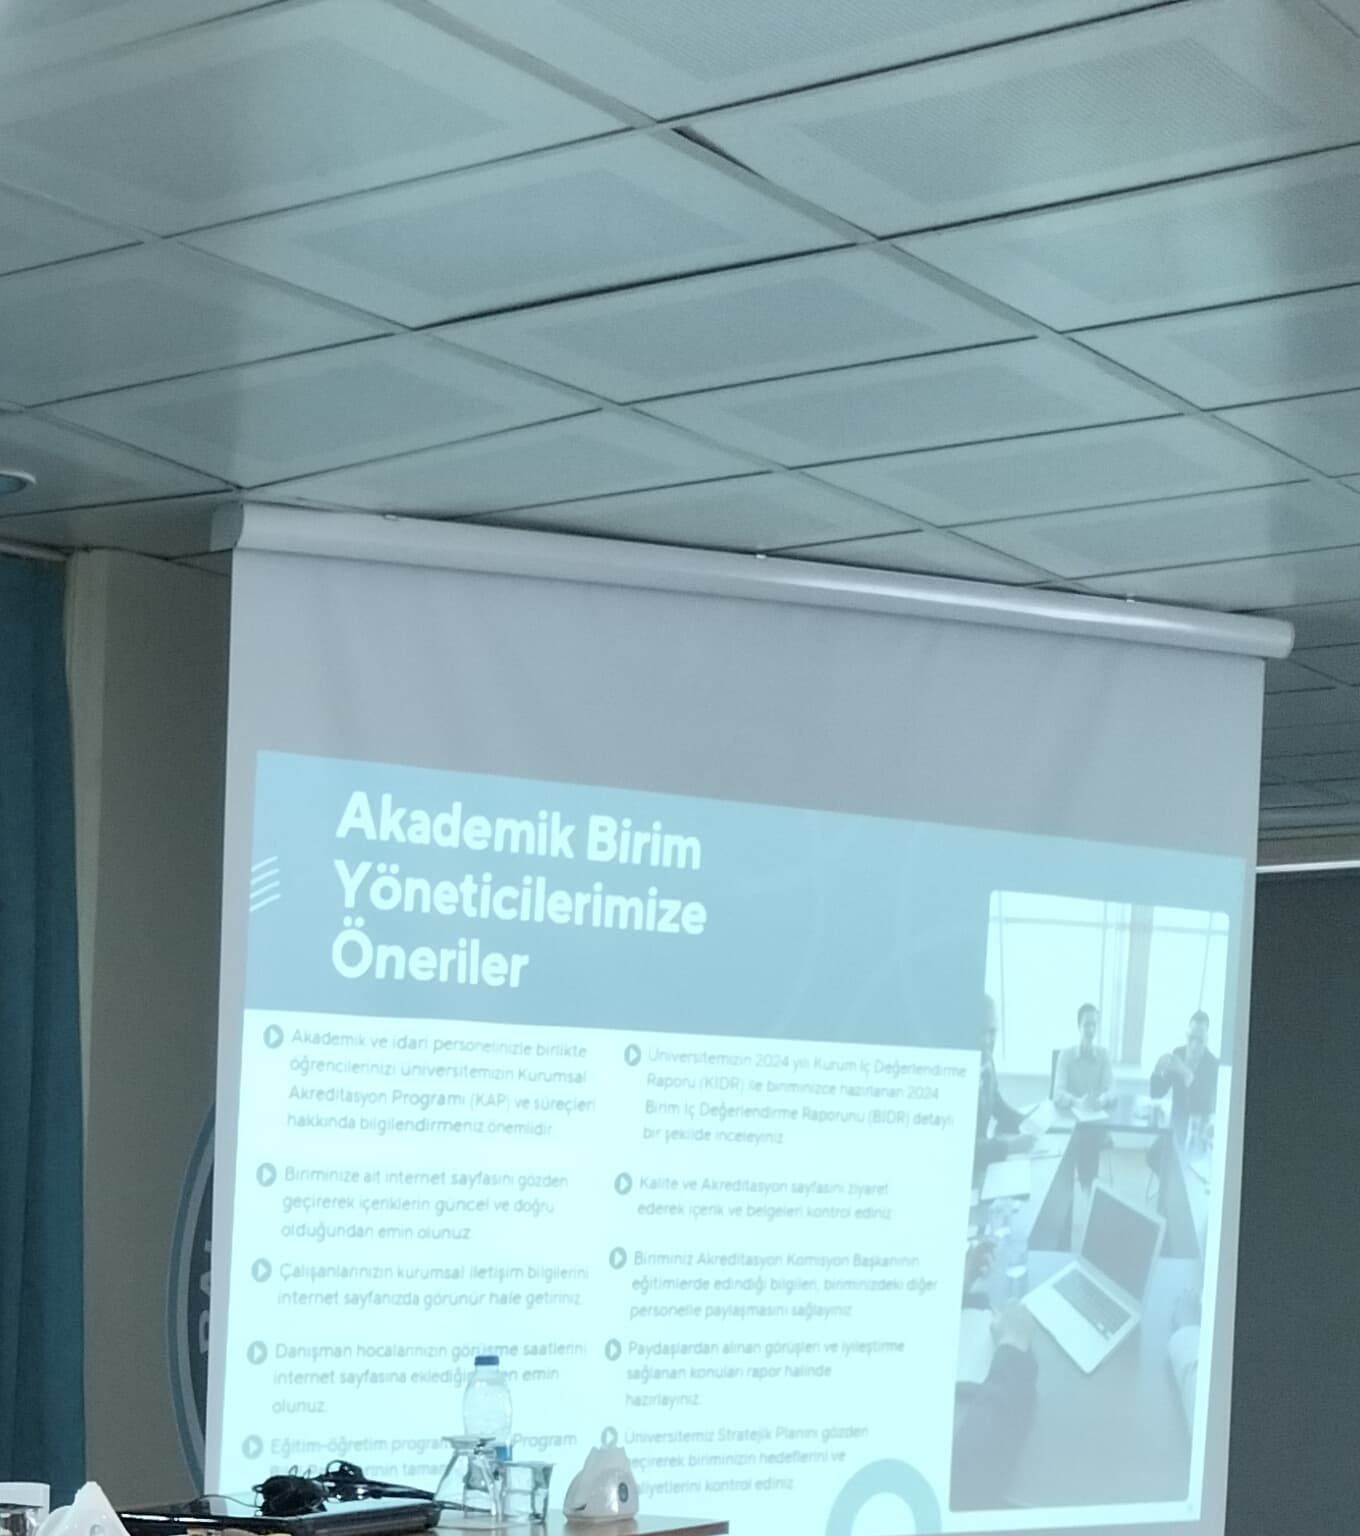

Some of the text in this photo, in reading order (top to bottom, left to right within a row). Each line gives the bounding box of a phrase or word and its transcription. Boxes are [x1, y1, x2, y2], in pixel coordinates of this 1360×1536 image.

[335, 791, 702, 870] Akademik Birim
[333, 859, 707, 935] Yöneticilerimize
[332, 916, 530, 988] Öneriler
[291, 1029, 365, 1046] Akademik
[372, 1037, 387, 1048] ve
[393, 1035, 428, 1050] idari
[755, 1055, 789, 1068] 2024
[814, 1057, 856, 1072] Kurum
[518, 1068, 586, 1083] Kurumsal
[647, 1074, 696, 1091] Raporu
[907, 1086, 939, 1099] 2024
[288, 1086, 387, 1108] Akreditasyon
[393, 1091, 465, 1111] Programı
[470, 1093, 509, 1111] (KAP)
[515, 1098, 530, 1109] ve
[802, 1107, 864, 1124] Raporunu
[285, 1167, 359, 1182] Biriminize
[385, 1170, 446, 1185] internet
[640, 1177, 678, 1190] Kalite
[683, 1180, 697, 1190] ve
[701, 1178, 788, 1197] Akreditasyon
[494, 1200, 509, 1210] ve
[638, 1202, 684, 1215] ederek
[729, 1206, 742, 1216] ve
[807, 1204, 850, 1218] kontrol
[378, 1226, 413, 1238] emin
[697, 1252, 782, 1270] Akreditasyon
[398, 1264, 464, 1280] kurumsal
[278, 1291, 339, 1305] internet
[489, 1293, 521, 1305] hale
[824, 1343, 838, 1352] ve
[273, 1369, 335, 1384] internet
[522, 1369, 559, 1381] emin
[747, 1366, 781, 1381] rapor
[785, 1365, 832, 1378] halinde
[514, 1433, 577, 1447] Program
[628, 1453, 685, 1470] eçirerek
[832, 1452, 846, 1461] ve
[705, 1478, 751, 1492] kontrol
